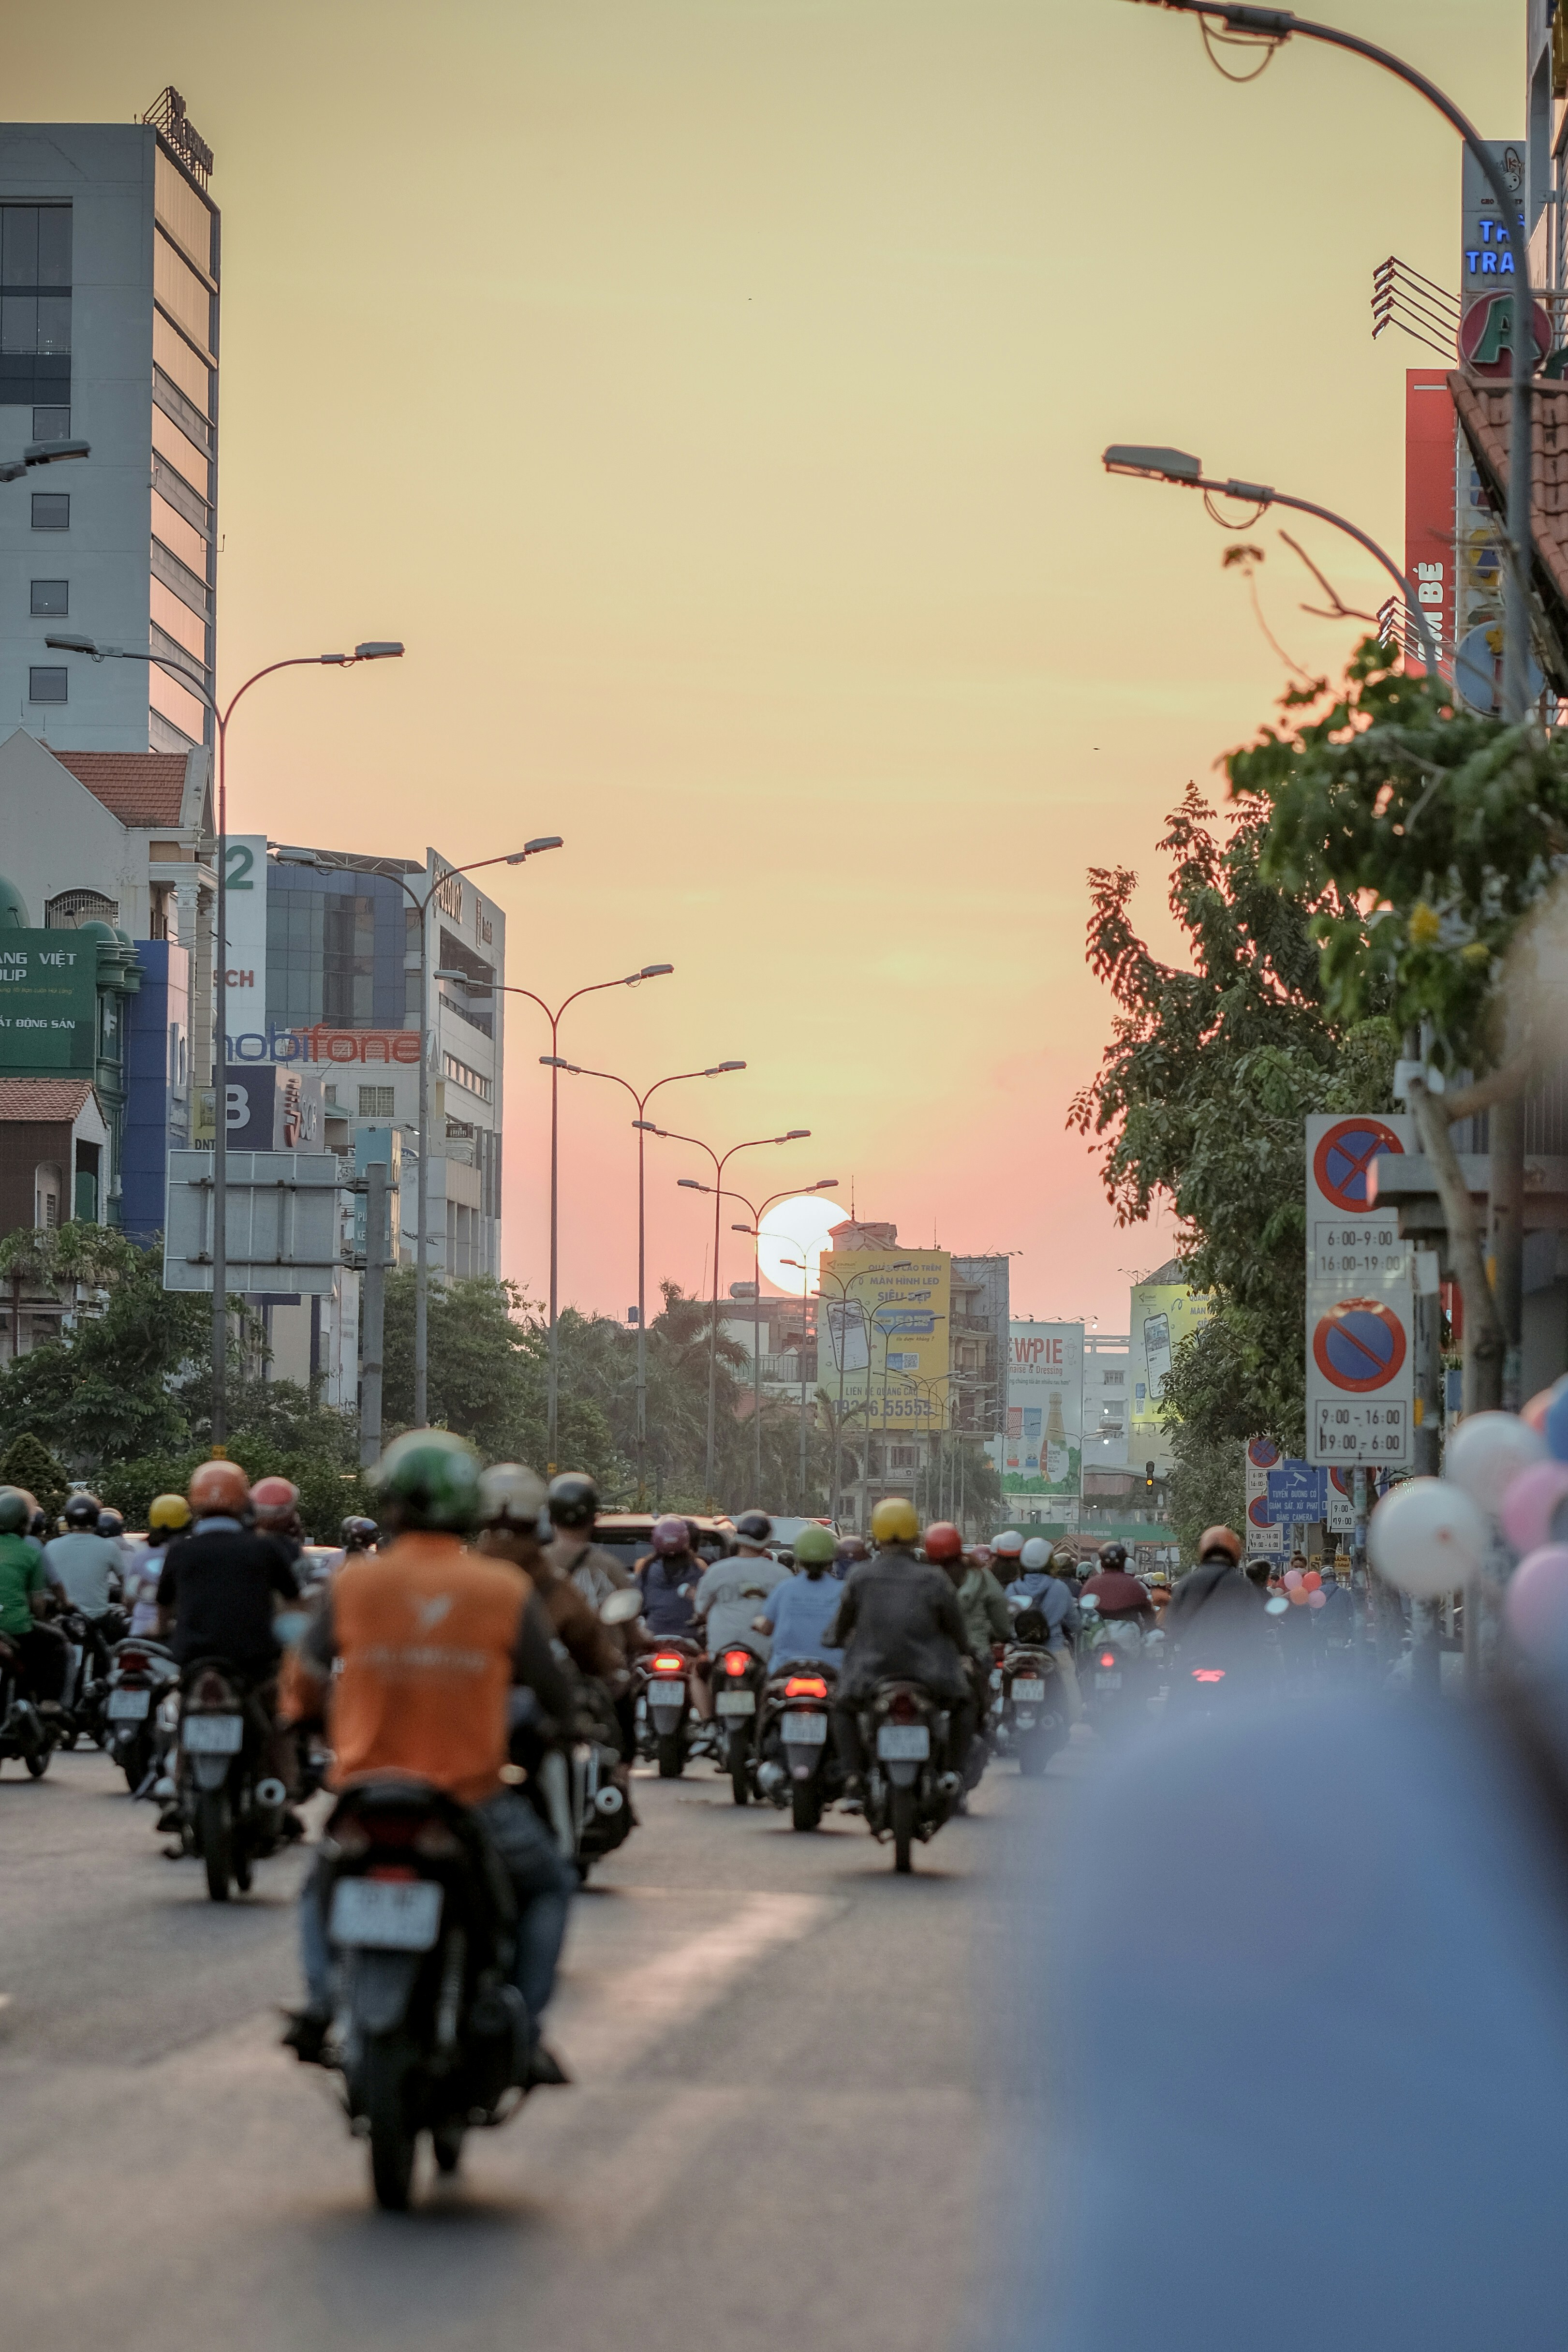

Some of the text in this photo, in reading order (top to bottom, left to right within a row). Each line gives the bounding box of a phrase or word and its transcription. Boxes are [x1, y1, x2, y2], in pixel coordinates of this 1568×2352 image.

[1465, 251, 1515, 274] TRA
[1412, 562, 1443, 604] BÉ
[225, 845, 254, 889] 2
[39, 950, 77, 967] VIỆT
[0, 969, 27, 981] UP
[15, 1017, 47, 1029] ĐỘNG
[51, 1018, 75, 1029] SẢN
[921, 1263, 941, 1272] TRÊN
[870, 1275, 893, 1285] MÀN
[896, 1275, 920, 1285] HÌNH
[877, 1289, 904, 1302] SIÊU
[1036, 1366, 1063, 1376] Dressing
[846, 1386, 862, 1395] LIÊN
[1322, 1409, 1349, 1423] 9:00
[1366, 1409, 1400, 1424] 16:00
[1372, 1435, 1400, 1450] 6:00
